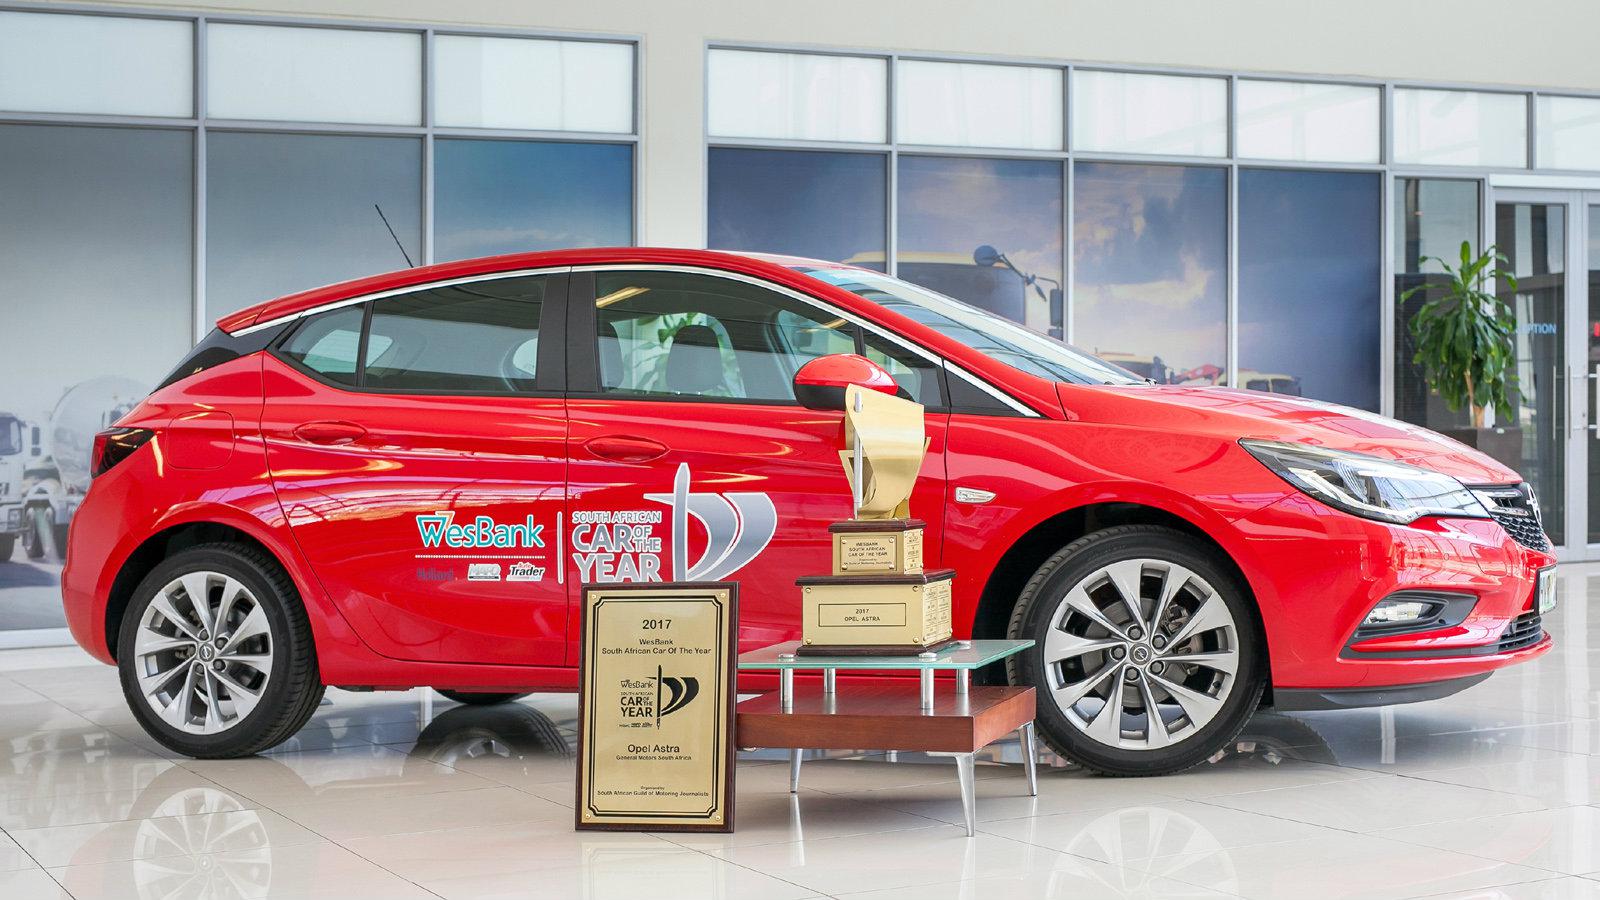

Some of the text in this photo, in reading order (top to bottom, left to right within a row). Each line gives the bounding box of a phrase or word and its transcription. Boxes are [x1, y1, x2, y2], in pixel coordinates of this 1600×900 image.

[572, 511, 662, 524] SOUTH AFRICAN
[416, 511, 545, 548] WesBank
[572, 524, 653, 552] CAR OF
[633, 537, 662, 552] THE
[511, 566, 544, 577] Trader
[572, 553, 663, 583] YEAR
[642, 619, 672, 630] 2017
[639, 638, 674, 646] WesBank
[652, 647, 667, 655] Car
[620, 679, 654, 688] WesBank
[620, 696, 643, 706] CAR
[620, 706, 654, 717] YEAR
[627, 744, 680, 754] Opel Astra
